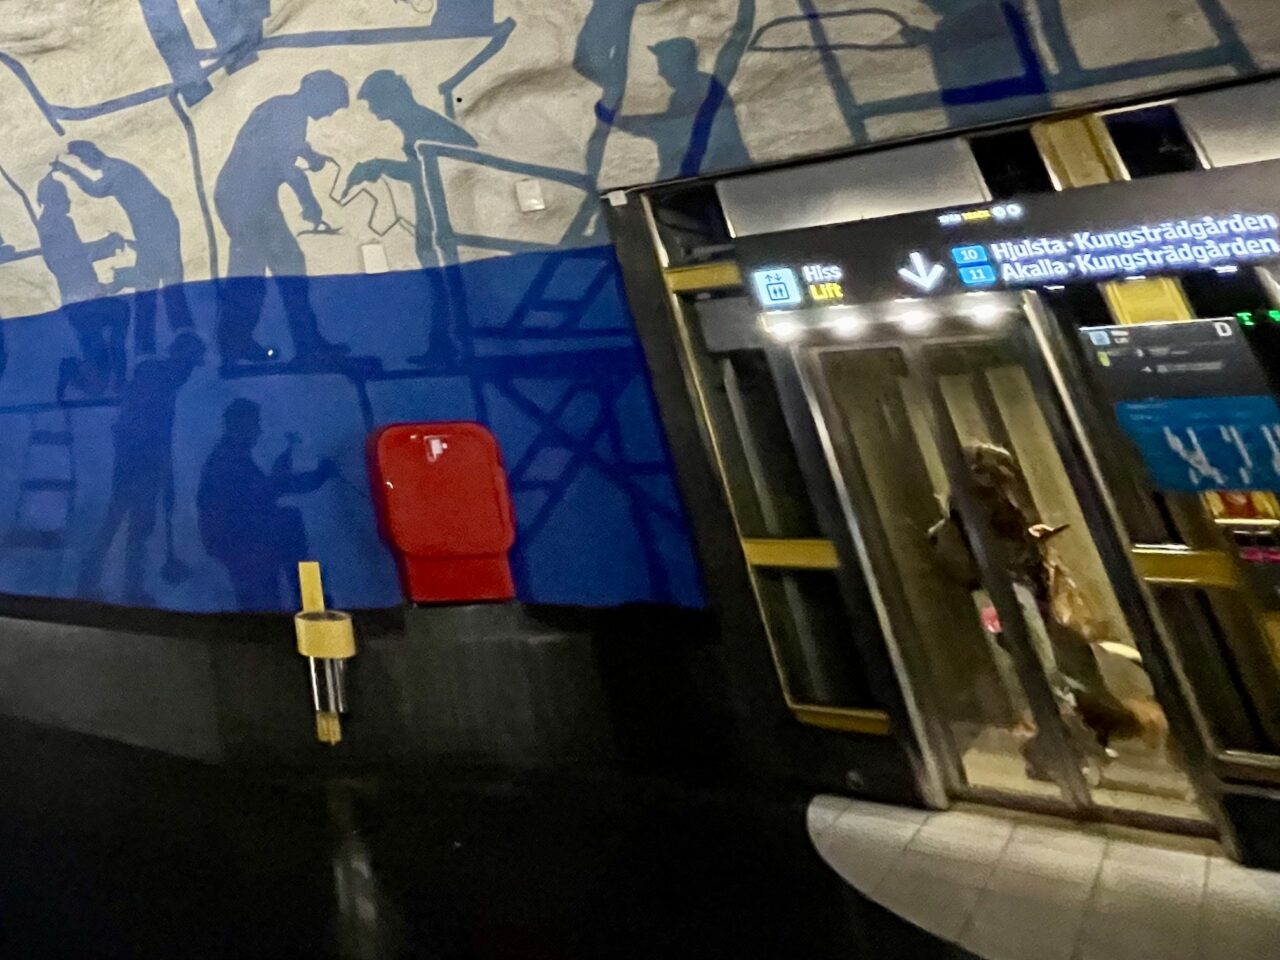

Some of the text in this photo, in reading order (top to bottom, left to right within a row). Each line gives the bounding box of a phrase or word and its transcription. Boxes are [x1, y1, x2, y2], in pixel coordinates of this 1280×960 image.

[990, 213, 1278, 261] Hjulsta Kungsträdgården
[960, 248, 978, 261] 10
[1001, 236, 1280, 281] Akalla Kungsträdgården
[802, 264, 842, 282] Hiss
[969, 268, 985, 280] 11
[809, 282, 844, 300] Lift
